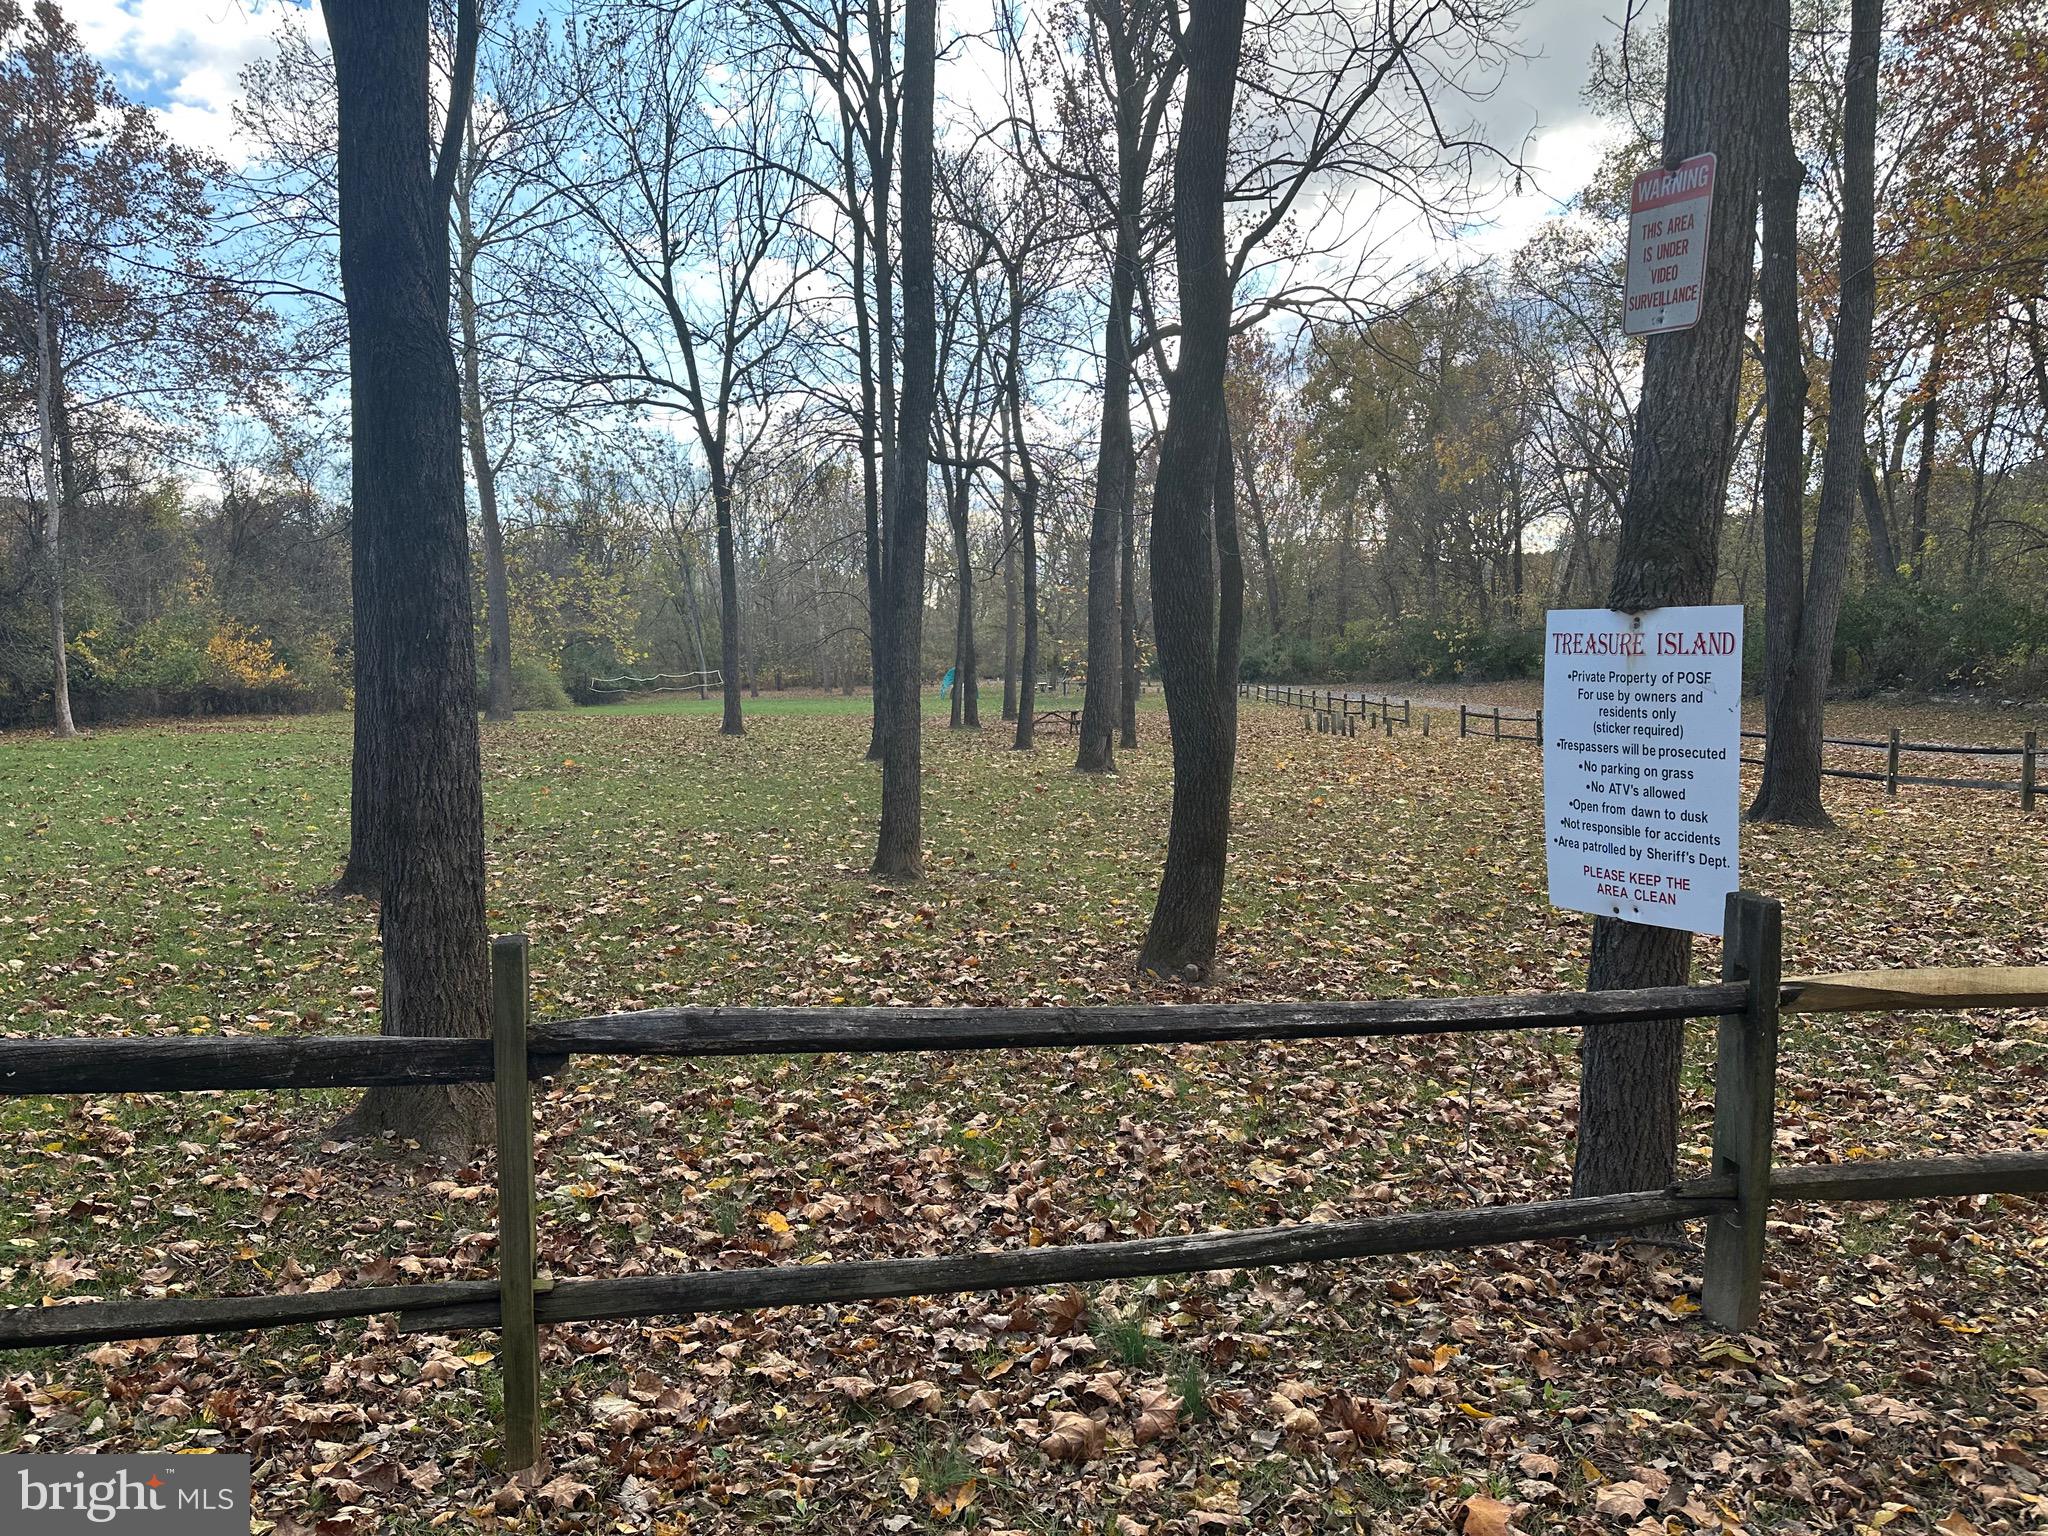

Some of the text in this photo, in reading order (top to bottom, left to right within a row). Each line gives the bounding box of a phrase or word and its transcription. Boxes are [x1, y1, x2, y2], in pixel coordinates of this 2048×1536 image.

[1638, 164, 1709, 203] WARNING
[1642, 213, 1694, 241] THIS AREA
[1643, 239, 1688, 263] IS UNDER
[1651, 265, 1678, 285] VIDEO
[1628, 285, 1698, 311] SURVEILLANCE
[1553, 632, 1735, 656] TREASURE ISLAND
[1609, 671, 1657, 686] Property
[1662, 672, 1674, 684] of
[1678, 672, 1712, 684] POSF
[1578, 688, 1703, 704] For use by owners and
[1599, 707, 1676, 722] residents only
[1593, 721, 1684, 739] (sticker required)
[1622, 744, 1639, 755] will
[1642, 744, 1656, 756] be
[1658, 748, 1726, 760] prosecuted
[1601, 762, 1640, 778] parking
[1644, 766, 1657, 777] on
[1662, 768, 1694, 780] grass
[1609, 783, 1639, 797] ATV's
[1643, 787, 1686, 800] allowed
[1602, 802, 1625, 815] from
[1631, 806, 1660, 819] dawn
[1664, 809, 1676, 820] to
[1680, 811, 1708, 823] dusk
[1582, 821, 1641, 837] responsible
[1645, 827, 1661, 839] for
[1664, 831, 1721, 845] accidents
[1583, 840, 1626, 855] patrolled
[1630, 845, 1642, 860] by
[1647, 848, 1695, 864] Sheriff's
[1700, 854, 1730, 870] Dept.
[1584, 865, 1690, 890] PLEASE KEEP THE
[1597, 883, 1676, 905] AREA CLEAN
